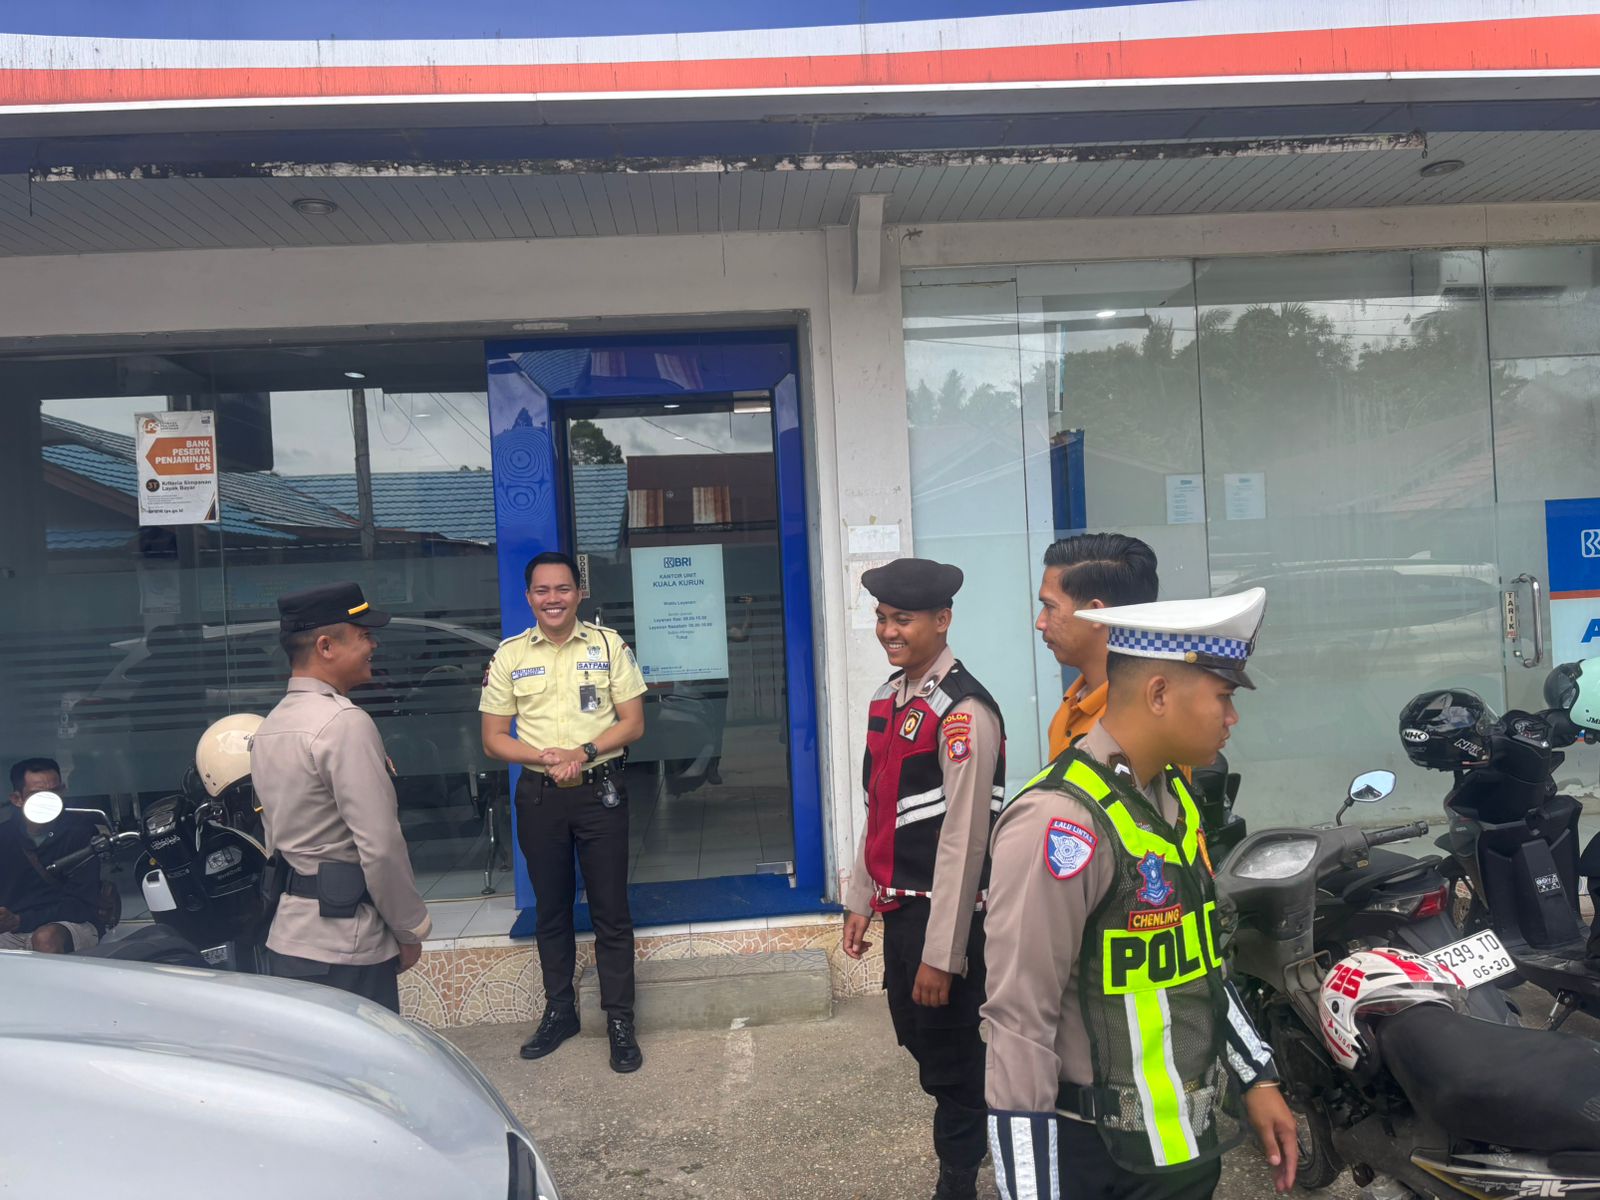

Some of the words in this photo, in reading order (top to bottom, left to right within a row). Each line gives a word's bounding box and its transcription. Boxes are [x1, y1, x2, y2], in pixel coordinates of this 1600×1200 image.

[155, 456, 210, 464] PENJAMINAN
[674, 557, 692, 567] BRI
[1507, 592, 1515, 630] TARIK
[578, 662, 609, 670] SATPAM
[943, 714, 968, 724] POLDA
[1403, 731, 1426, 740] NHK
[1054, 821, 1072, 830] LALU
[1133, 908, 1180, 928] CHENLING
[1434, 944, 1475, 969] 5299
[1476, 934, 1500, 953] TD
